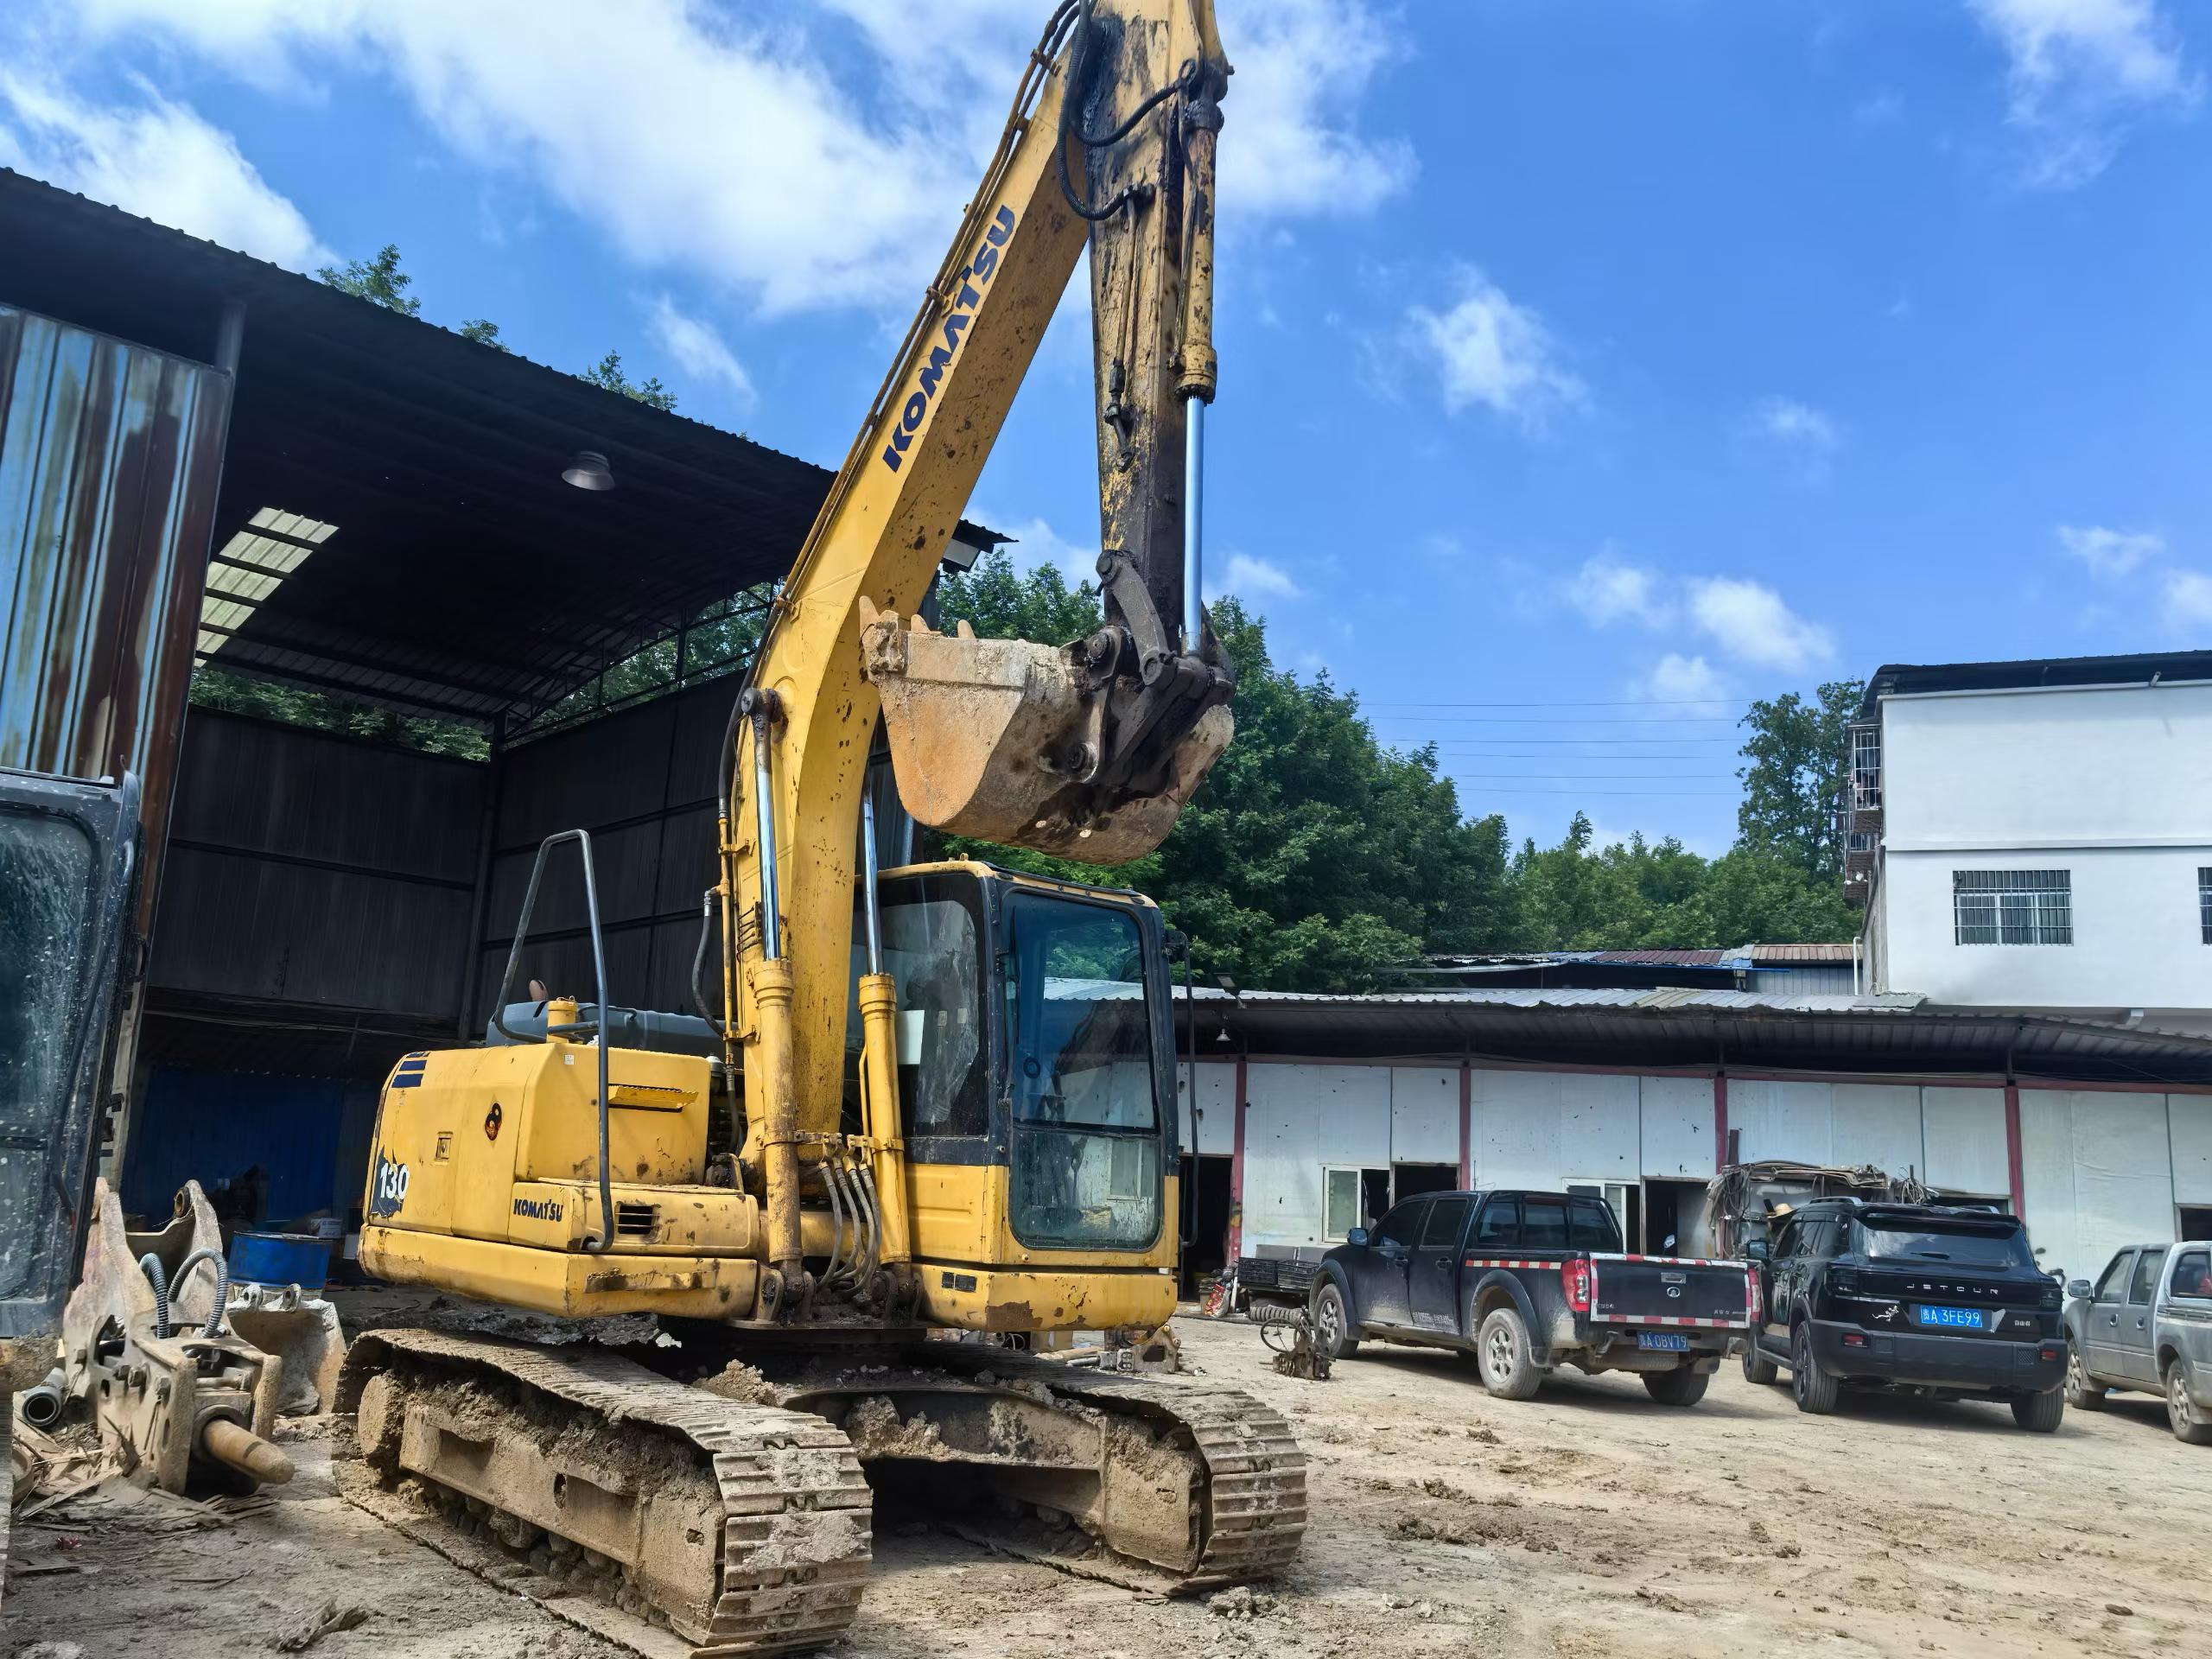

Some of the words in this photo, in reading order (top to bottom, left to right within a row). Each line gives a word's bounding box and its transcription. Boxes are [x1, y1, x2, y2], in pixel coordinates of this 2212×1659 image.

[882, 204, 1015, 473] KOMATSU
[380, 1163, 410, 1199] 130
[513, 1198, 563, 1222] KOMATSU
[1907, 1283, 1999, 1295] JETOUR
